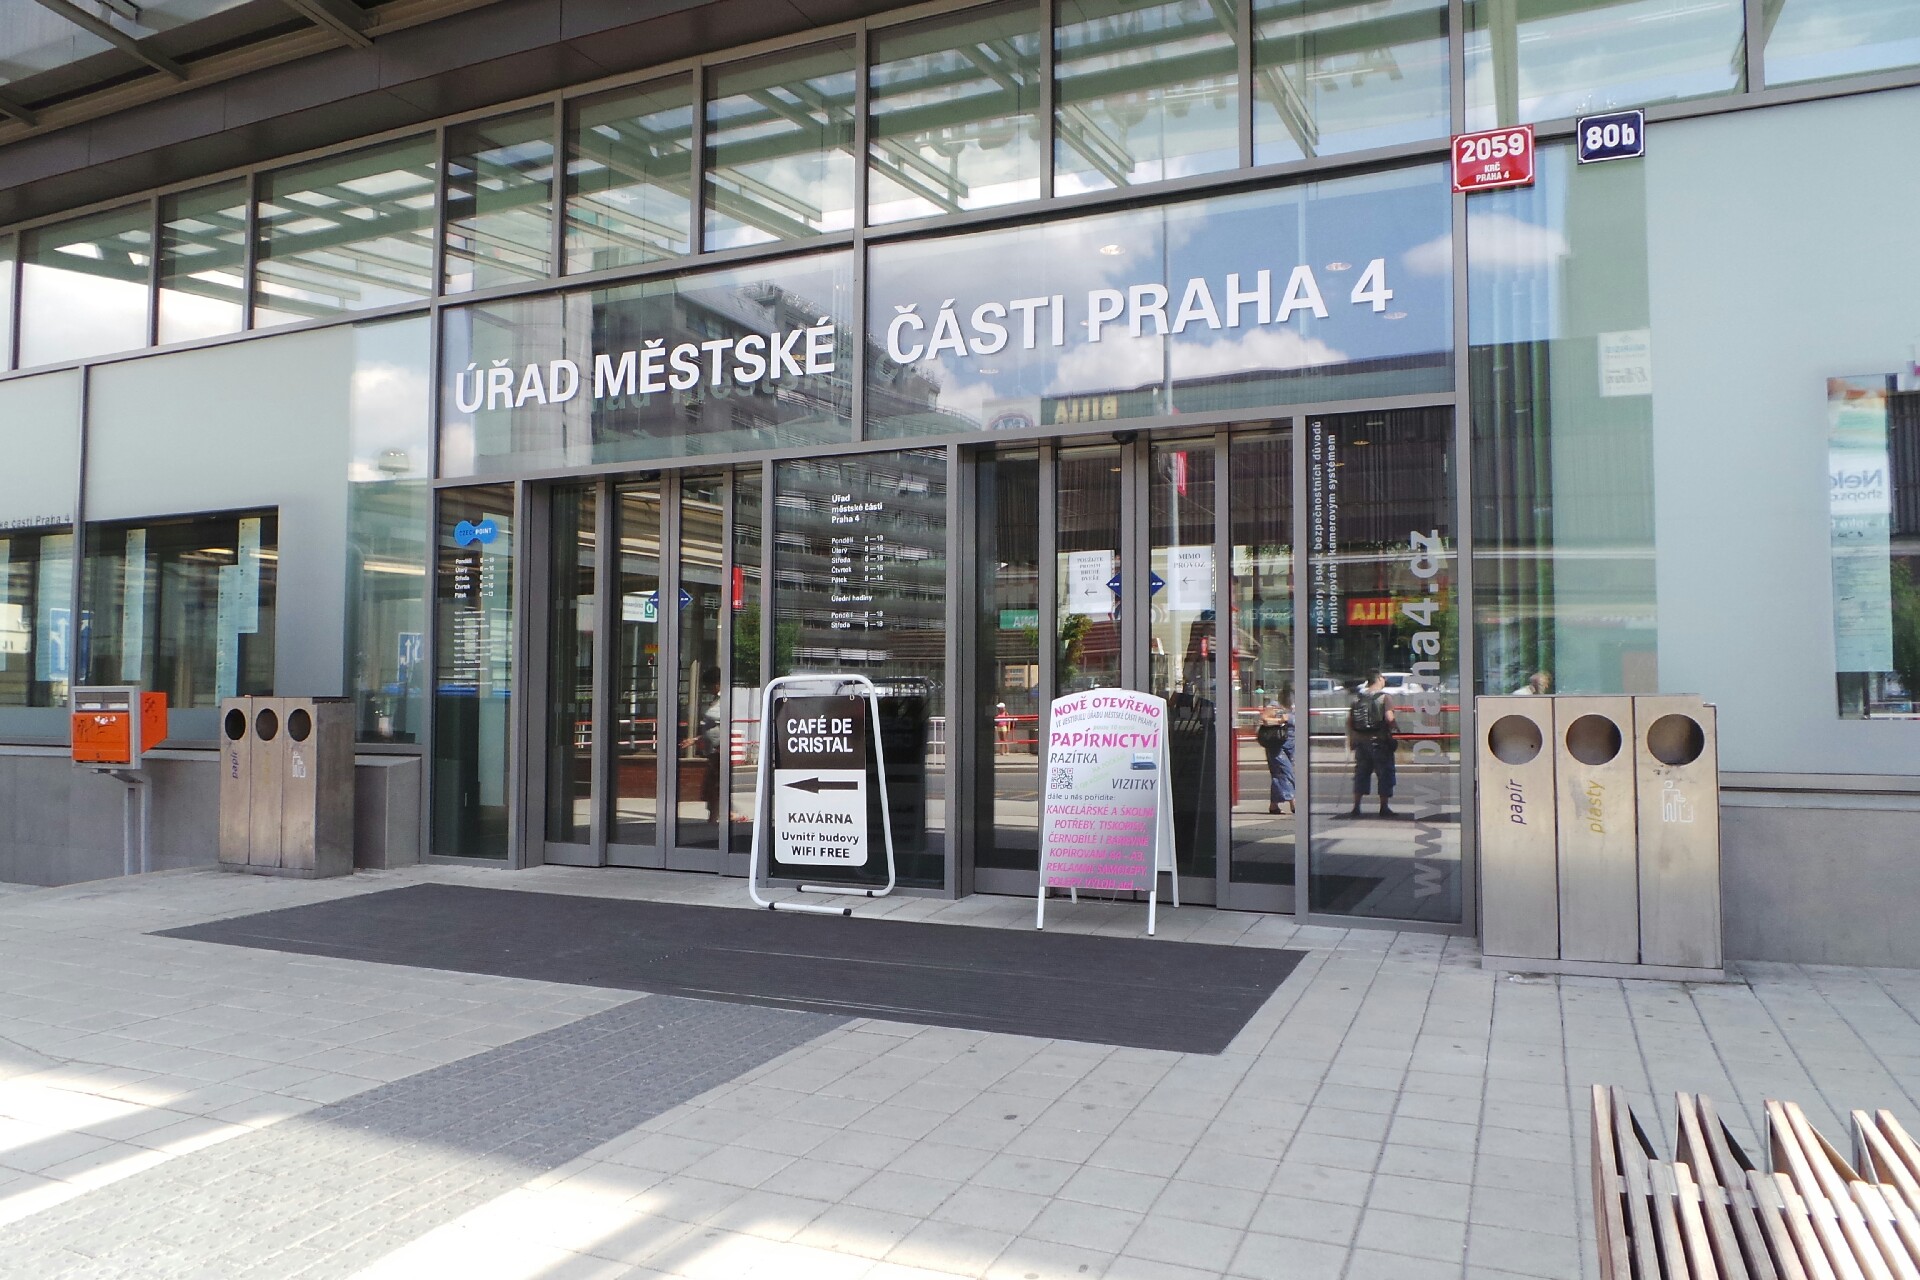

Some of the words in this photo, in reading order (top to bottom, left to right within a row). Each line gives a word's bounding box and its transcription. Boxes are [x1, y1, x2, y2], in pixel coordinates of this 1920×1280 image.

[1586, 123, 1636, 150] 80b
[1461, 133, 1525, 164] 2059
[1475, 171, 1502, 183] PRAHA
[1503, 170, 1511, 180] 4
[1484, 161, 1501, 173] KRČ
[455, 358, 580, 414] ÚŘAD
[594, 315, 836, 399] MĚSTSKÉ
[887, 294, 1065, 365] ČÁSTI
[1088, 265, 1329, 343] PRAHA
[1350, 258, 1394, 312] 4
[1311, 421, 1322, 461] důvodů
[1325, 434, 1337, 490] systémem
[832, 493, 851, 503] Úřad
[832, 504, 863, 514] městské
[864, 502, 883, 512] části
[1312, 464, 1323, 549] bezpečnostních
[36, 515, 61, 526] Praha
[832, 515, 854, 524] Praha
[854, 515, 860, 523] 4
[1327, 493, 1338, 556] kamerovým
[475, 527, 493, 536] POINT
[852, 594, 873, 603] hodiny
[1328, 560, 1339, 634] monitorovány
[1313, 592, 1325, 634] prostory
[1054, 696, 1088, 717] NOVĚ
[1092, 696, 1160, 718] OTEVŘENO
[1401, 529, 1450, 899] www.praha4.cz
[787, 715, 827, 735] CAFÉ
[831, 718, 852, 734] DE
[787, 737, 853, 753] CRISTAL
[1051, 728, 1160, 748] PAPÍRNICTVÍ
[230, 751, 239, 780] papír
[1050, 750, 1098, 764] RAZÍTKA
[1112, 779, 1158, 790] VIZITKY
[1046, 803, 1109, 816] KANCELÁŘSKÉ
[1111, 807, 1118, 815] A
[1505, 779, 1527, 825] papír
[1586, 780, 1605, 834] plasty
[788, 811, 853, 824] KAVÁRNA
[781, 832, 815, 841] Uvnitř
[819, 833, 859, 845] budovy
[792, 846, 816, 857] WIFI
[820, 848, 850, 858] FREE
